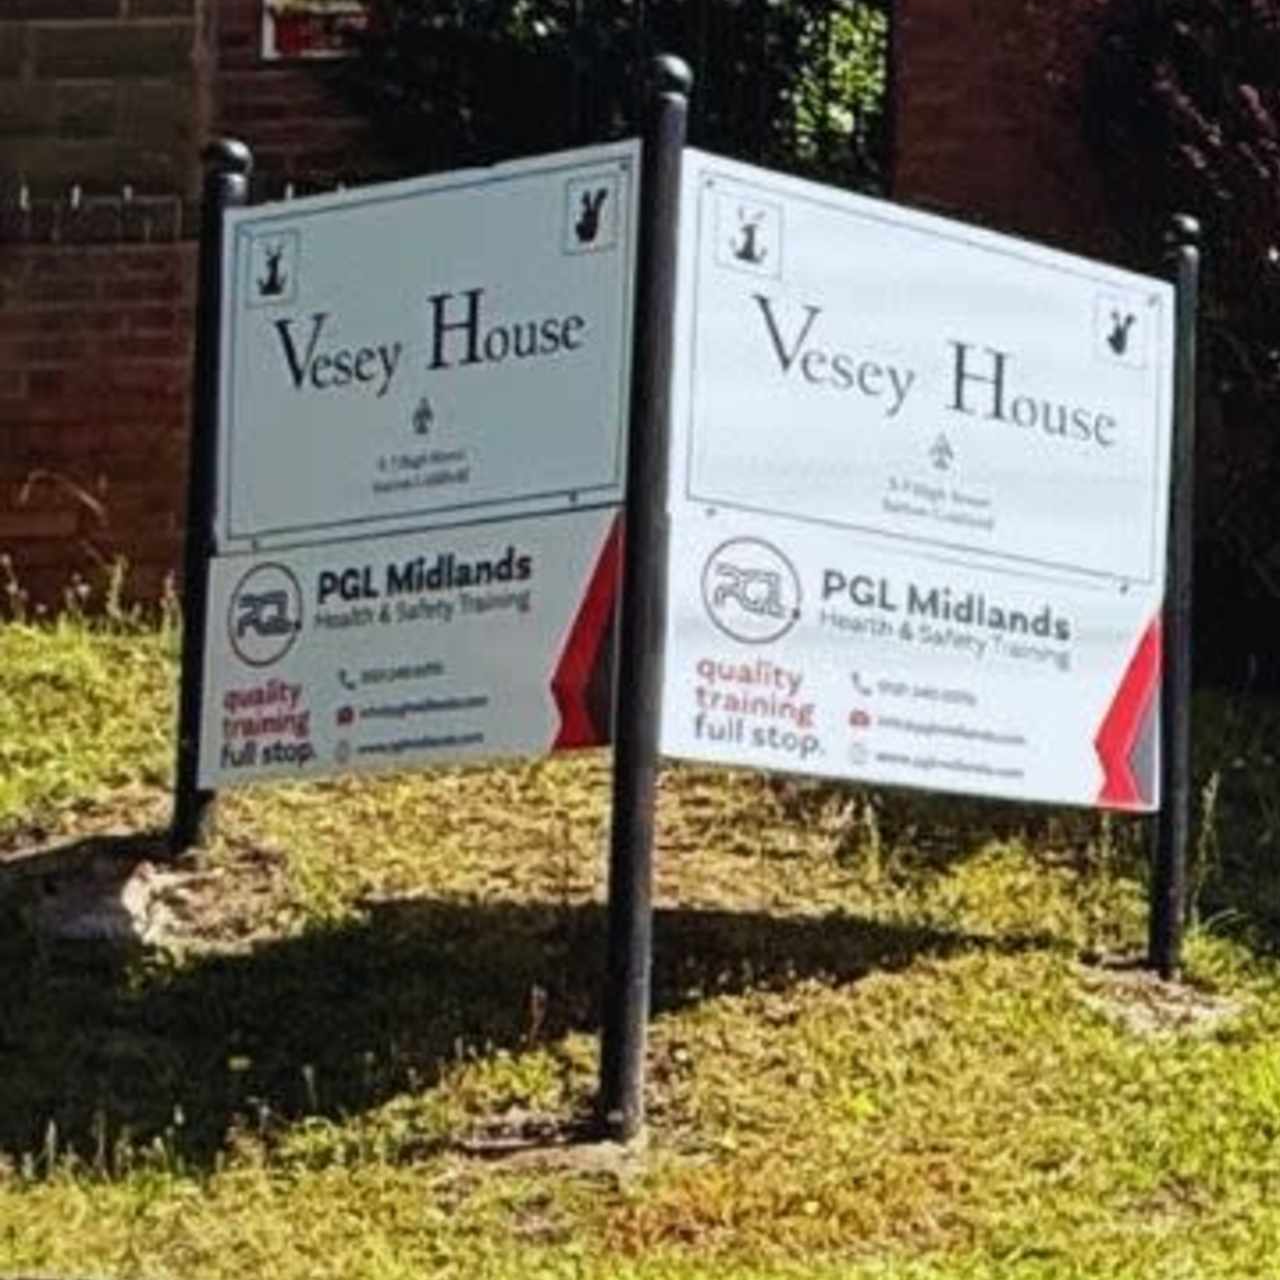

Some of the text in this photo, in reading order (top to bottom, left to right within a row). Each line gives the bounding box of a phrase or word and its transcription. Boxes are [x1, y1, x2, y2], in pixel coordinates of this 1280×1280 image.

[273, 288, 586, 397] Vesey House
[752, 294, 1118, 448] Vesey House
[318, 546, 532, 604] PGL Midlands
[314, 608, 375, 630] Health
[395, 597, 455, 624] Safety
[459, 588, 531, 614] Training
[821, 568, 1072, 641] PGL Midlands
[819, 610, 1074, 672] Health & Safety Training
[223, 680, 302, 712] quality
[696, 655, 803, 694] quality
[221, 710, 310, 740] training
[696, 685, 816, 729] training
[220, 738, 258, 768] full
[694, 711, 826, 760] full stop.
